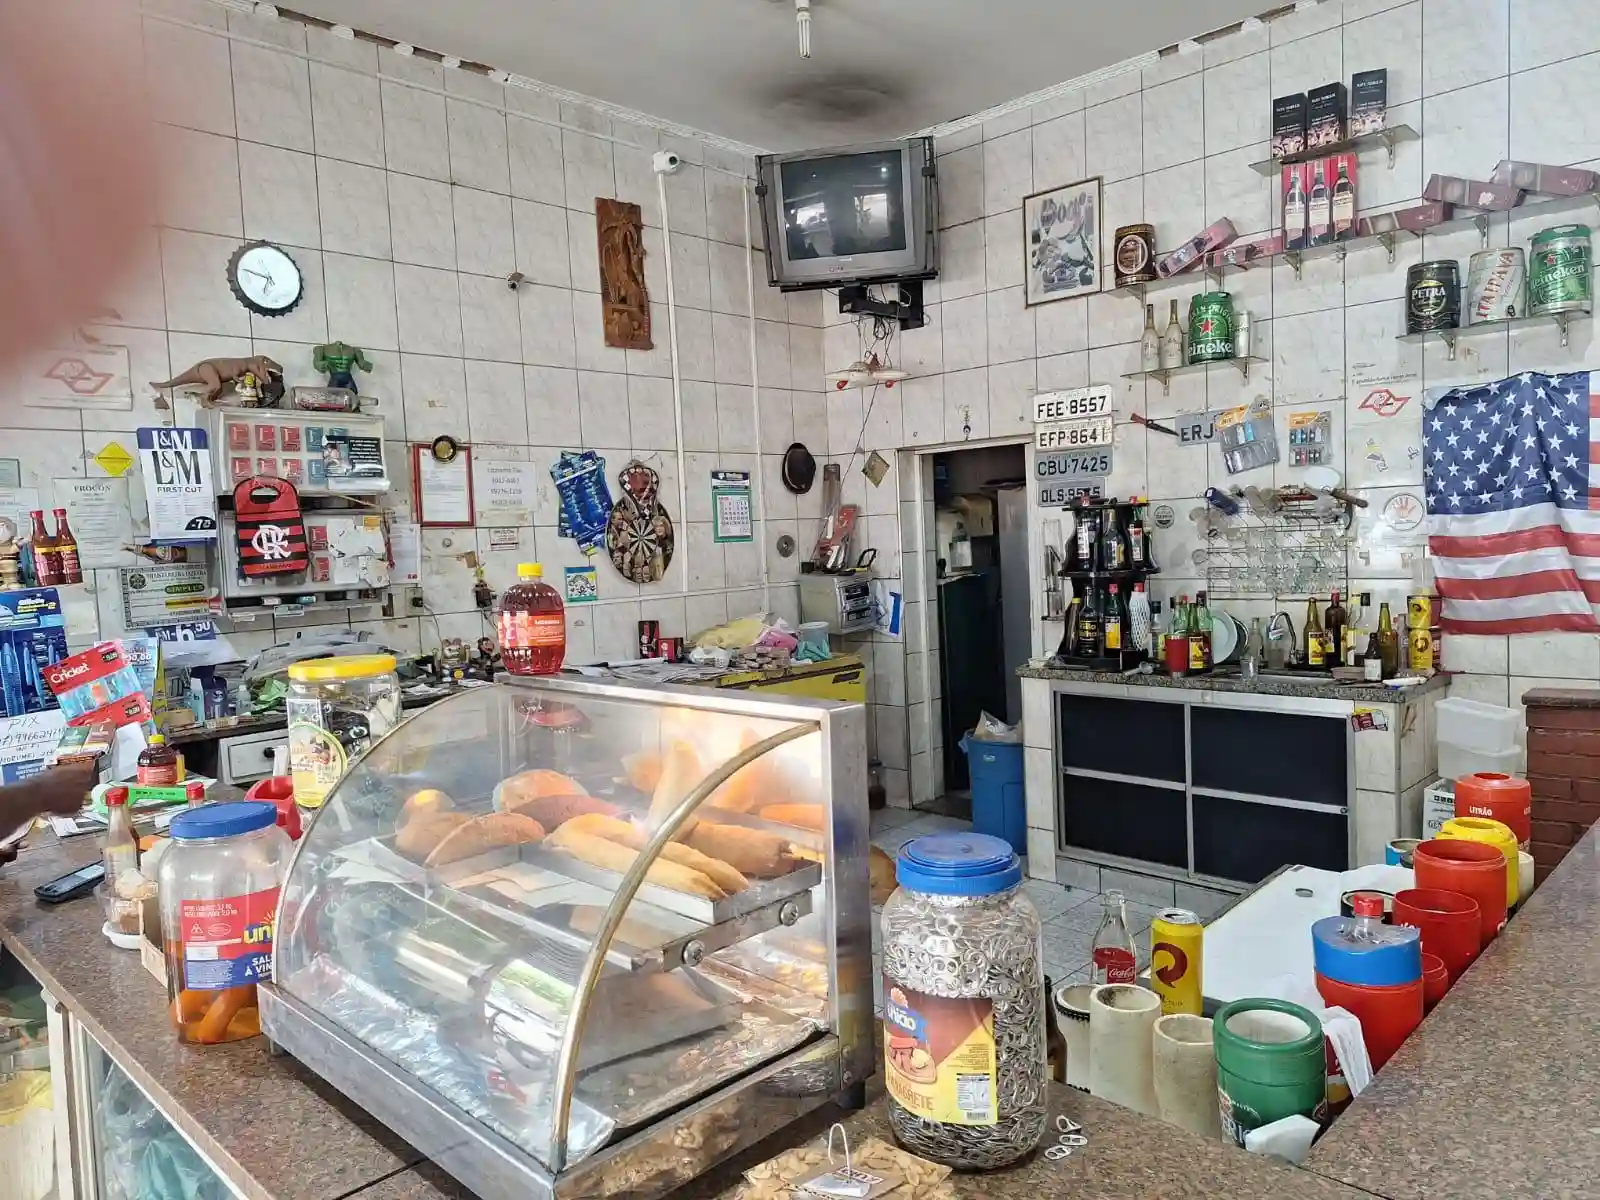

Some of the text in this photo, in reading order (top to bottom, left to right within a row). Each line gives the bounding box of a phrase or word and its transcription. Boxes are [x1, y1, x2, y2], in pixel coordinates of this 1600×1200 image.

[1411, 288, 1446, 301] PETRA
[151, 450, 203, 485] L&M
[50, 663, 91, 683] Cricket
[1469, 805, 1493, 816] LITRÃO
